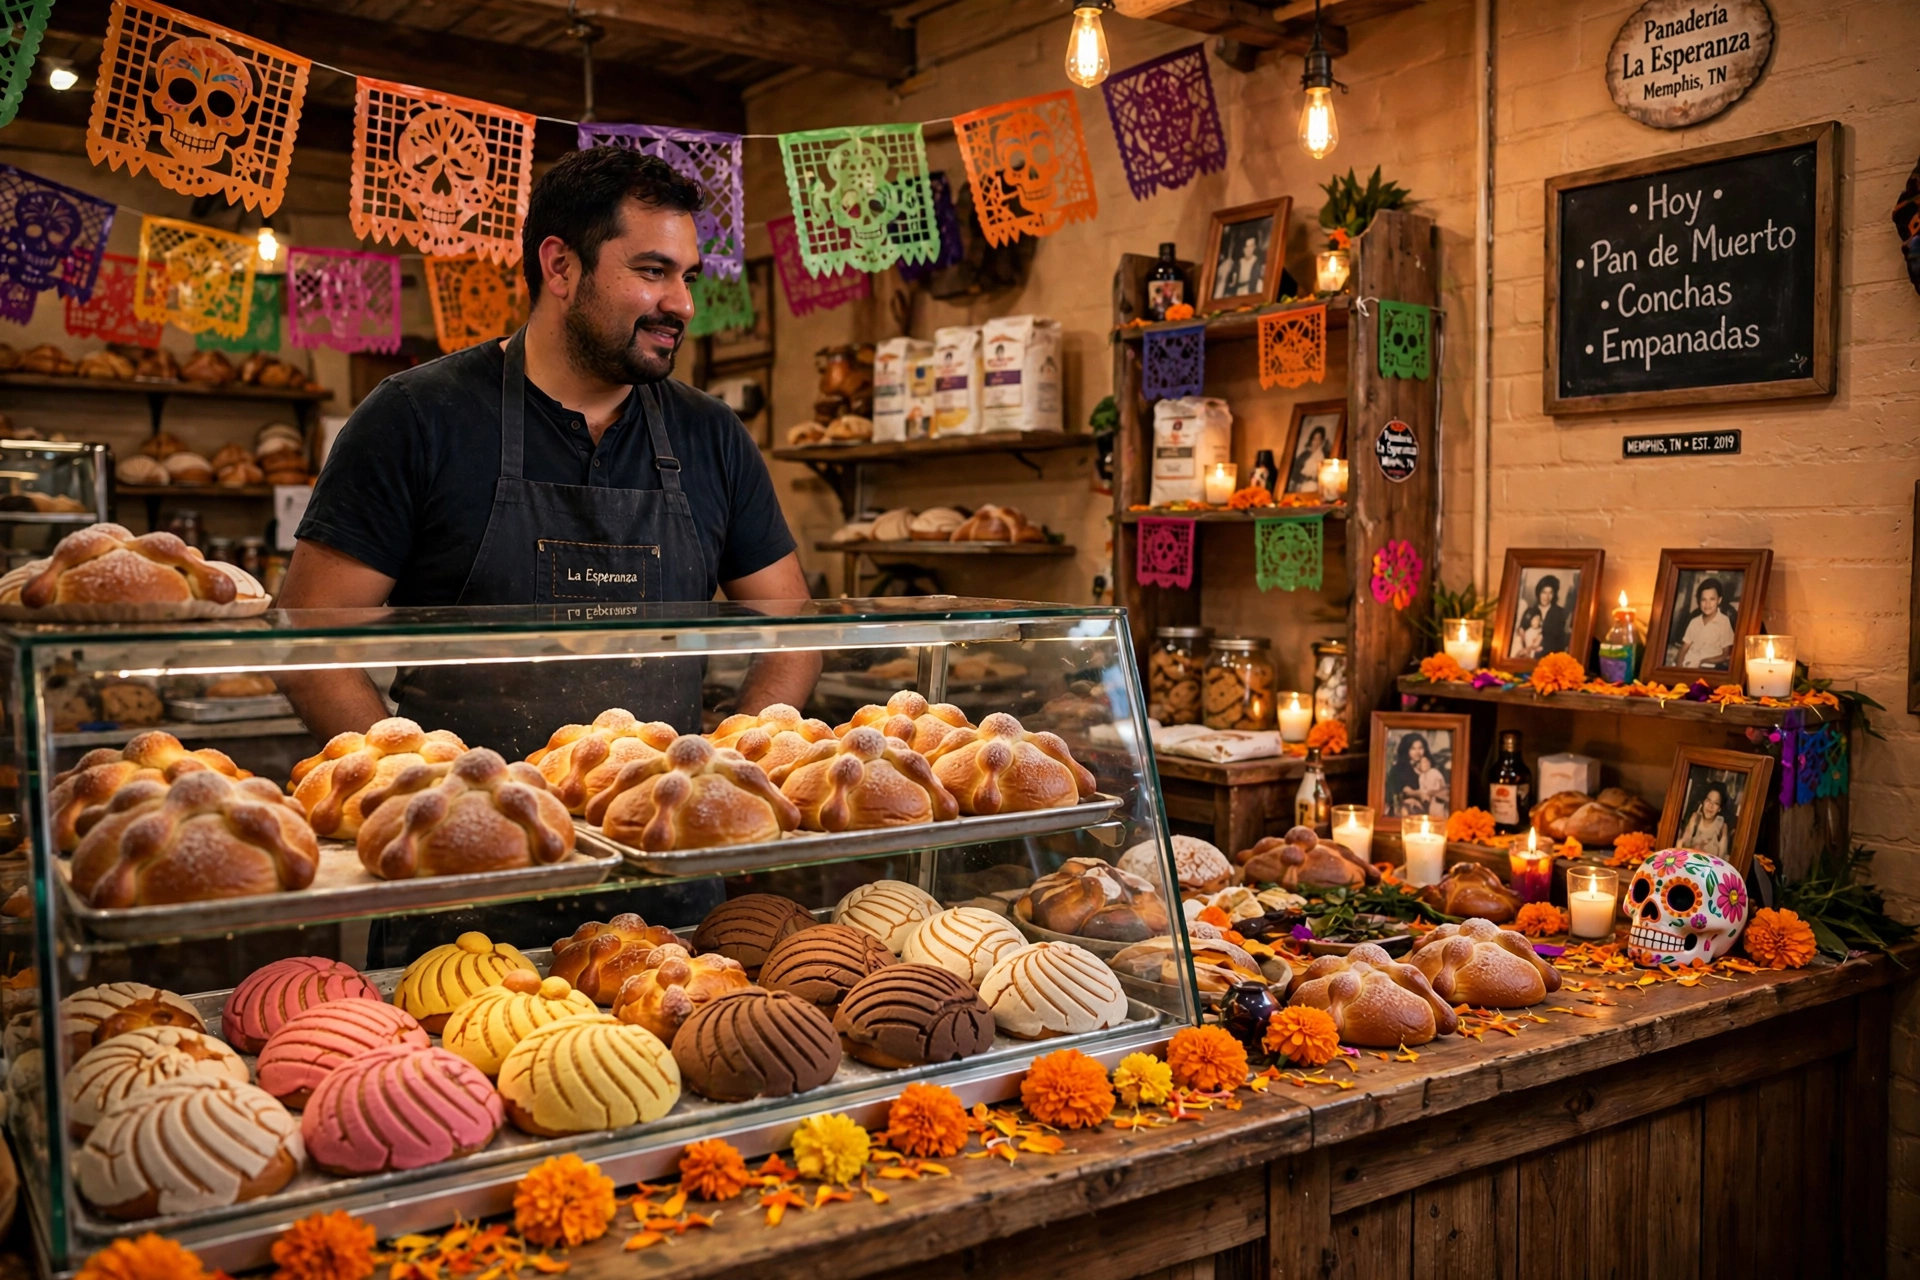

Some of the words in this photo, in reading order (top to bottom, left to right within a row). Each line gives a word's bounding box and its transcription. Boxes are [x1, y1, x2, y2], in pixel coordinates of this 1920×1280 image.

[1644, 3, 1729, 44] Panadería
[1622, 53, 1645, 80] La
[1650, 31, 1751, 75] Esperanza
[1643, 74, 1704, 100] Memphis,
[1707, 65, 1728, 86] TN
[1648, 183, 1702, 225] Hoy
[1590, 239, 1638, 277] Pan
[1648, 233, 1679, 268] de
[1692, 218, 1796, 263] Muerto
[1617, 274, 1733, 318] Conchas
[1602, 314, 1760, 372] Empanadas
[1627, 439, 1668, 454] MEMPHIS,
[1669, 438, 1682, 451] TN
[1691, 437, 1711, 451] EST.
[1713, 435, 1735, 450] 2019
[567, 568, 581, 581] La
[585, 568, 638, 586] Esperanza
